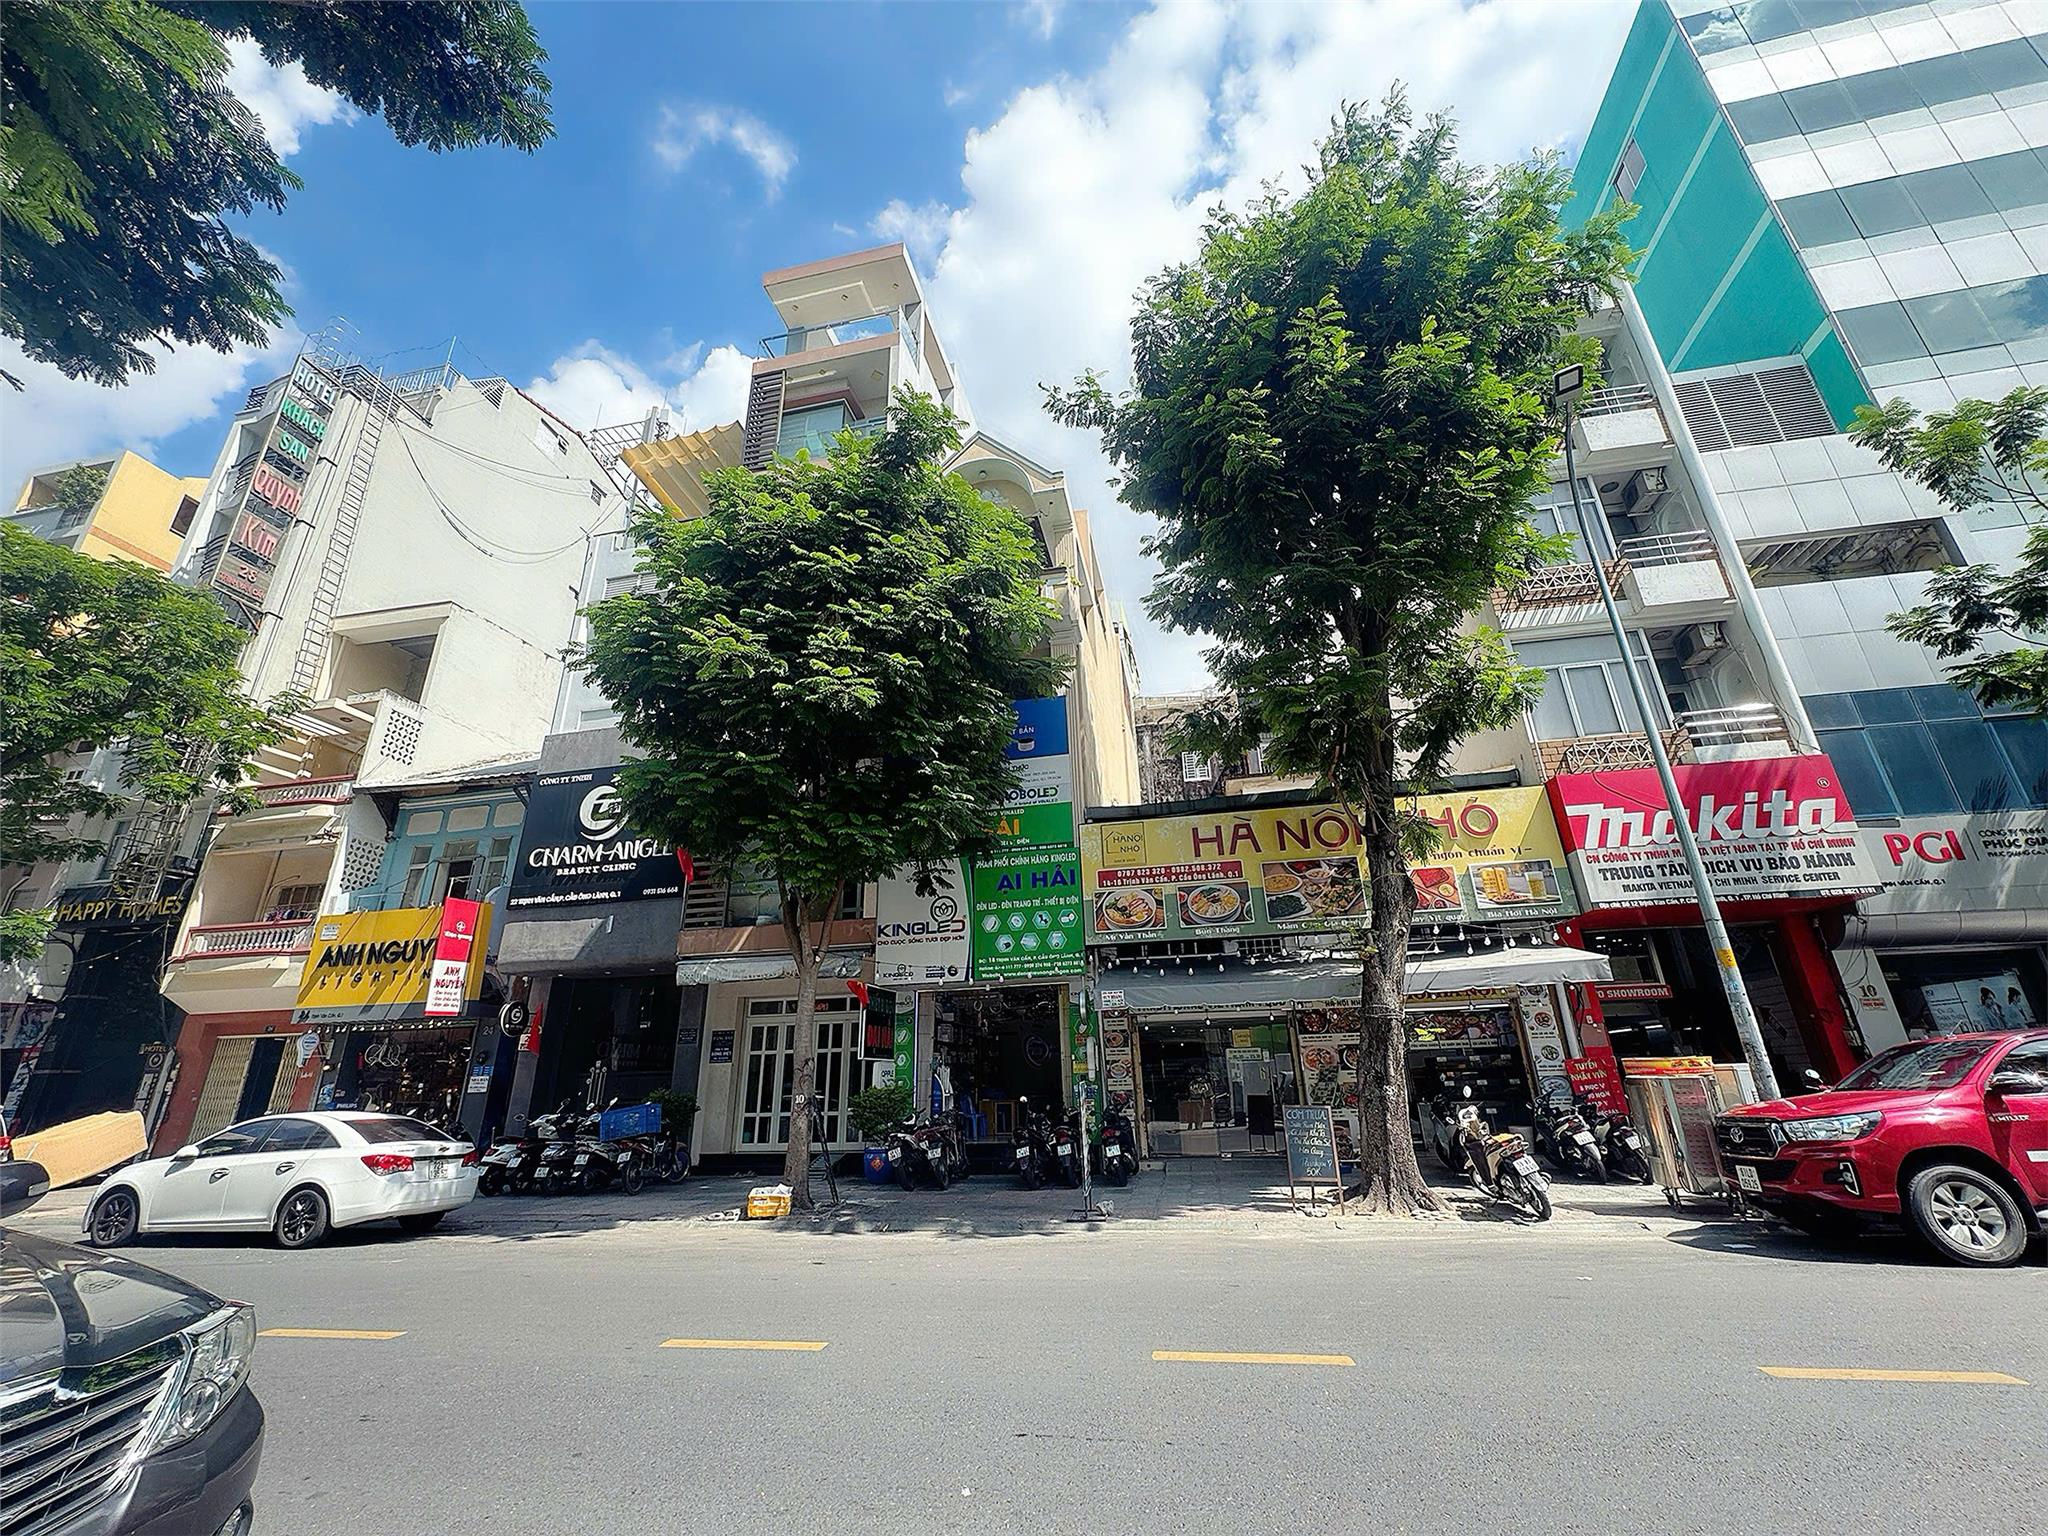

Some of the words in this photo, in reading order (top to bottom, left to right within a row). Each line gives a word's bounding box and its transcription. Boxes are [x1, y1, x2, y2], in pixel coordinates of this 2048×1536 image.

[240, 515, 278, 560] Kim
[238, 565, 257, 583] 28
[1006, 786, 1059, 800] OBOLED
[1191, 815, 1263, 858] HÀ
[1418, 797, 1499, 841] HỎ
[1602, 851, 1629, 863] CÔNG
[1630, 851, 1642, 862] TY
[1643, 849, 1671, 860] TNHH
[1711, 844, 1731, 856] VIỆT
[1734, 844, 1758, 854] NAM
[1758, 842, 1776, 854] TẠI
[1777, 842, 1790, 851] TP
[1791, 838, 1806, 851] HỒ
[1809, 837, 1825, 849] CHÍ
[1827, 837, 1857, 848] MINH
[1883, 830, 1967, 867] PGI
[1982, 836, 2023, 849] PHÚC
[556, 865, 600, 876] BEAUTY
[602, 862, 637, 872] CLINIC
[1031, 864, 1076, 889] HẢI
[1598, 863, 1655, 881] TRUNG
[1742, 857, 1764, 874] VỤ
[1767, 852, 1802, 871] BẢO
[1803, 850, 1857, 869] HÀNH
[1622, 882, 1657, 893] MAKITA
[1715, 877, 1731, 888] CHI
[1732, 875, 1759, 886] MINH
[1761, 872, 1801, 884] SERVICE
[1803, 871, 1841, 882] CENTER
[59, 900, 116, 921] HAPPY
[119, 896, 183, 921] HOMES
[1606, 987, 1669, 999] SHOWROOM
[1860, 984, 1878, 997] 10
[795, 1094, 805, 1104] 10
